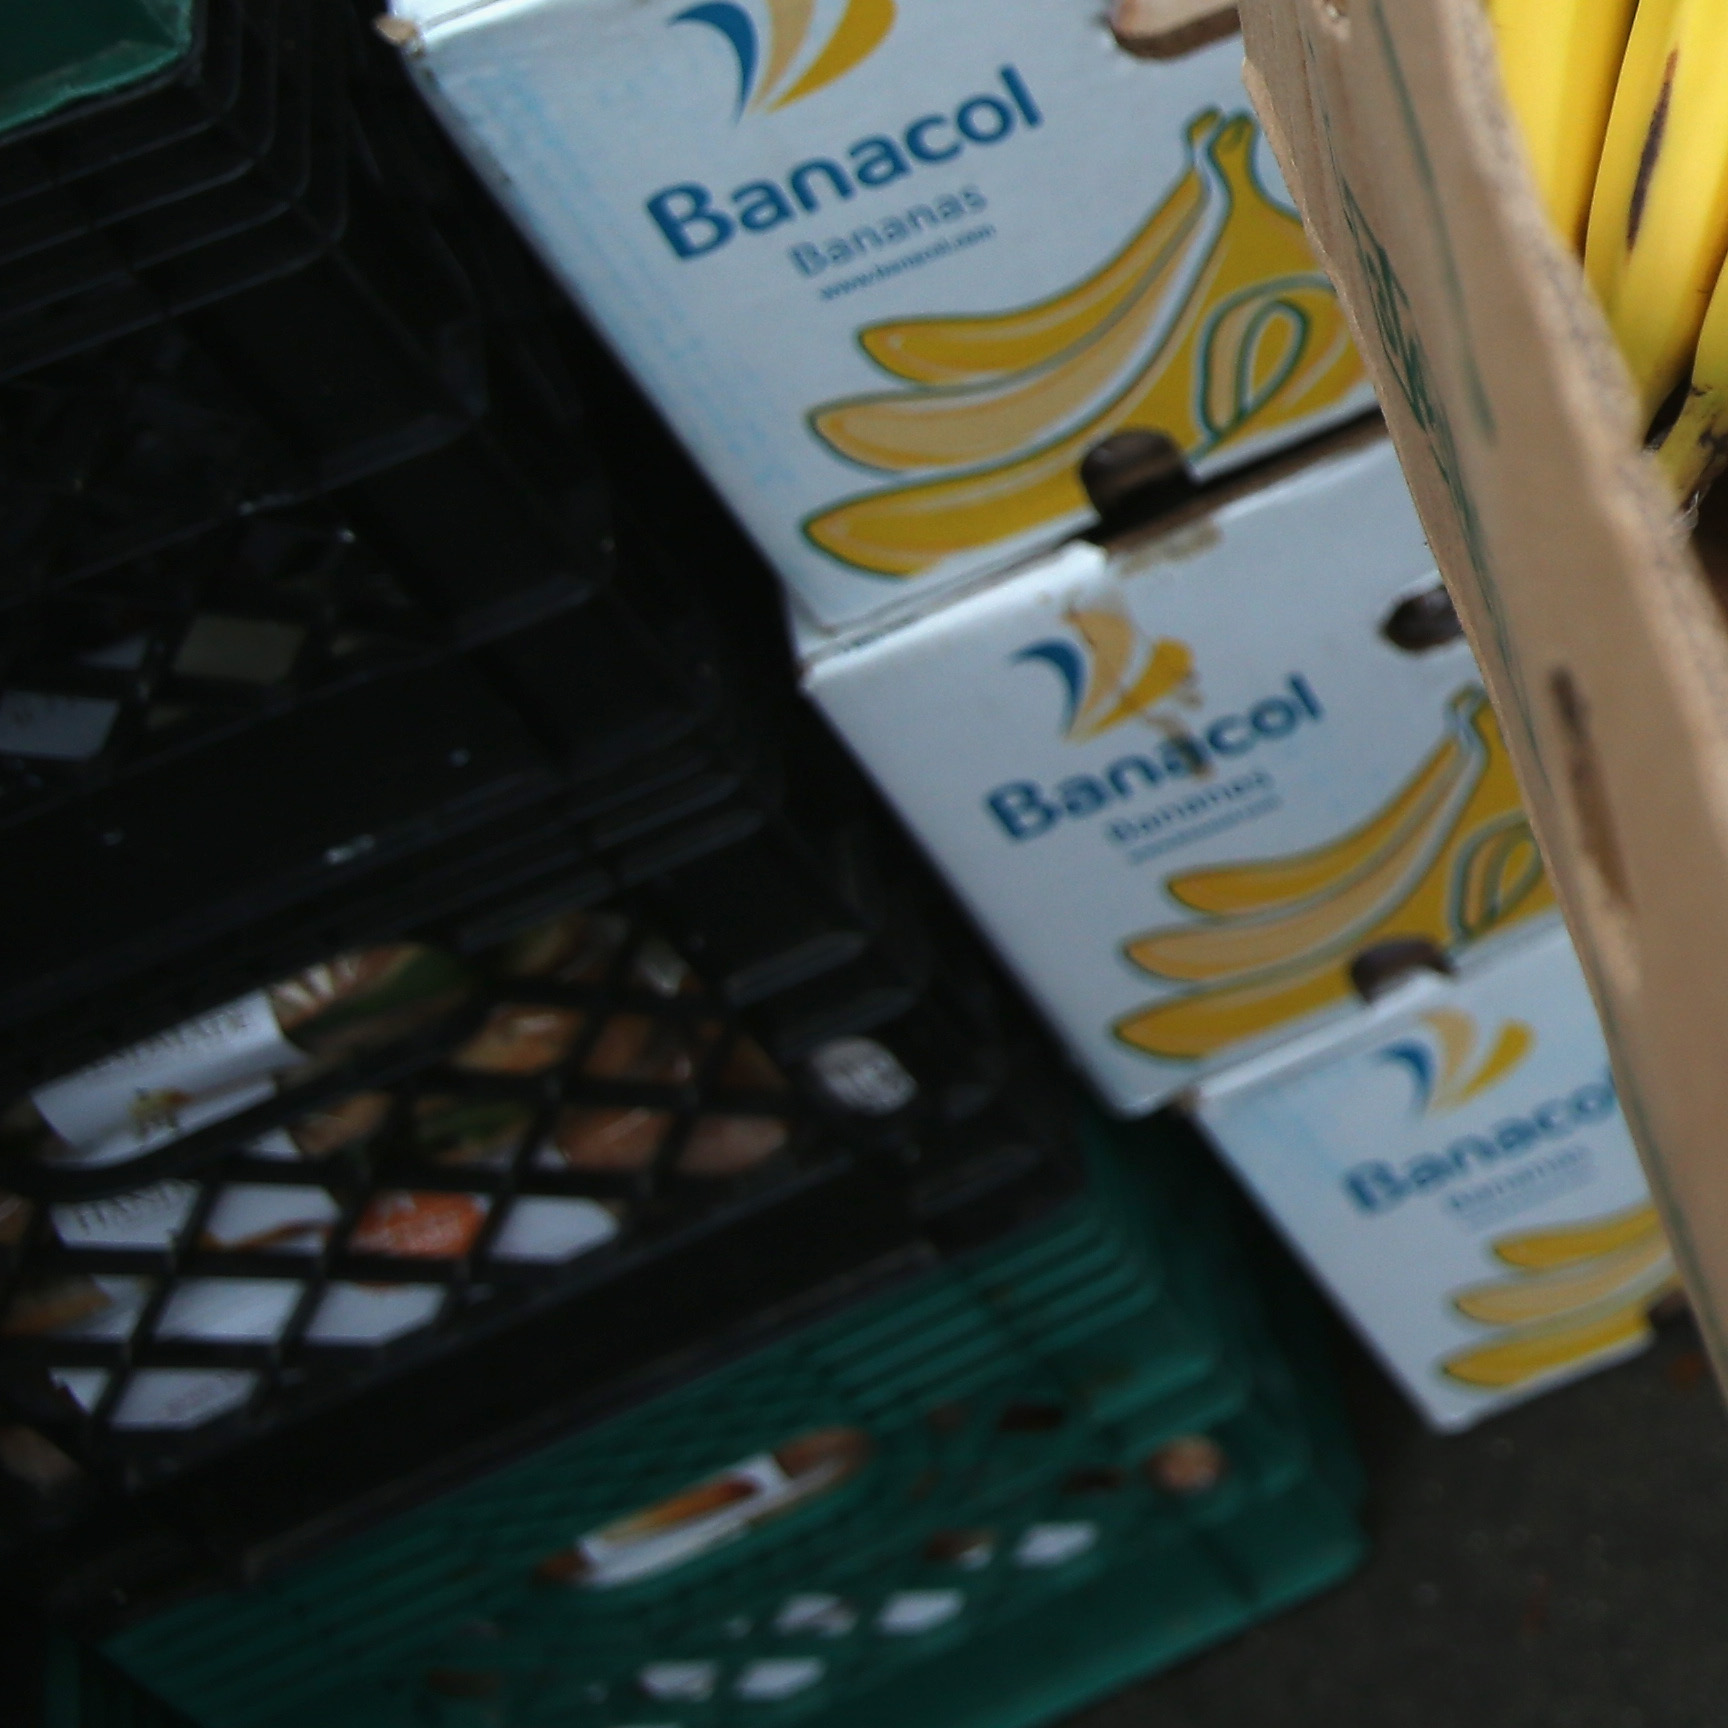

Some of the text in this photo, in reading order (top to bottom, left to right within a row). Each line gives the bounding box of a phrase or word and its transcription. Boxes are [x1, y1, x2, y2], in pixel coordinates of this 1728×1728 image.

[645, 64, 1045, 261] Banacol
[789, 183, 989, 279] Bananas
[983, 672, 1325, 842] Banacol
